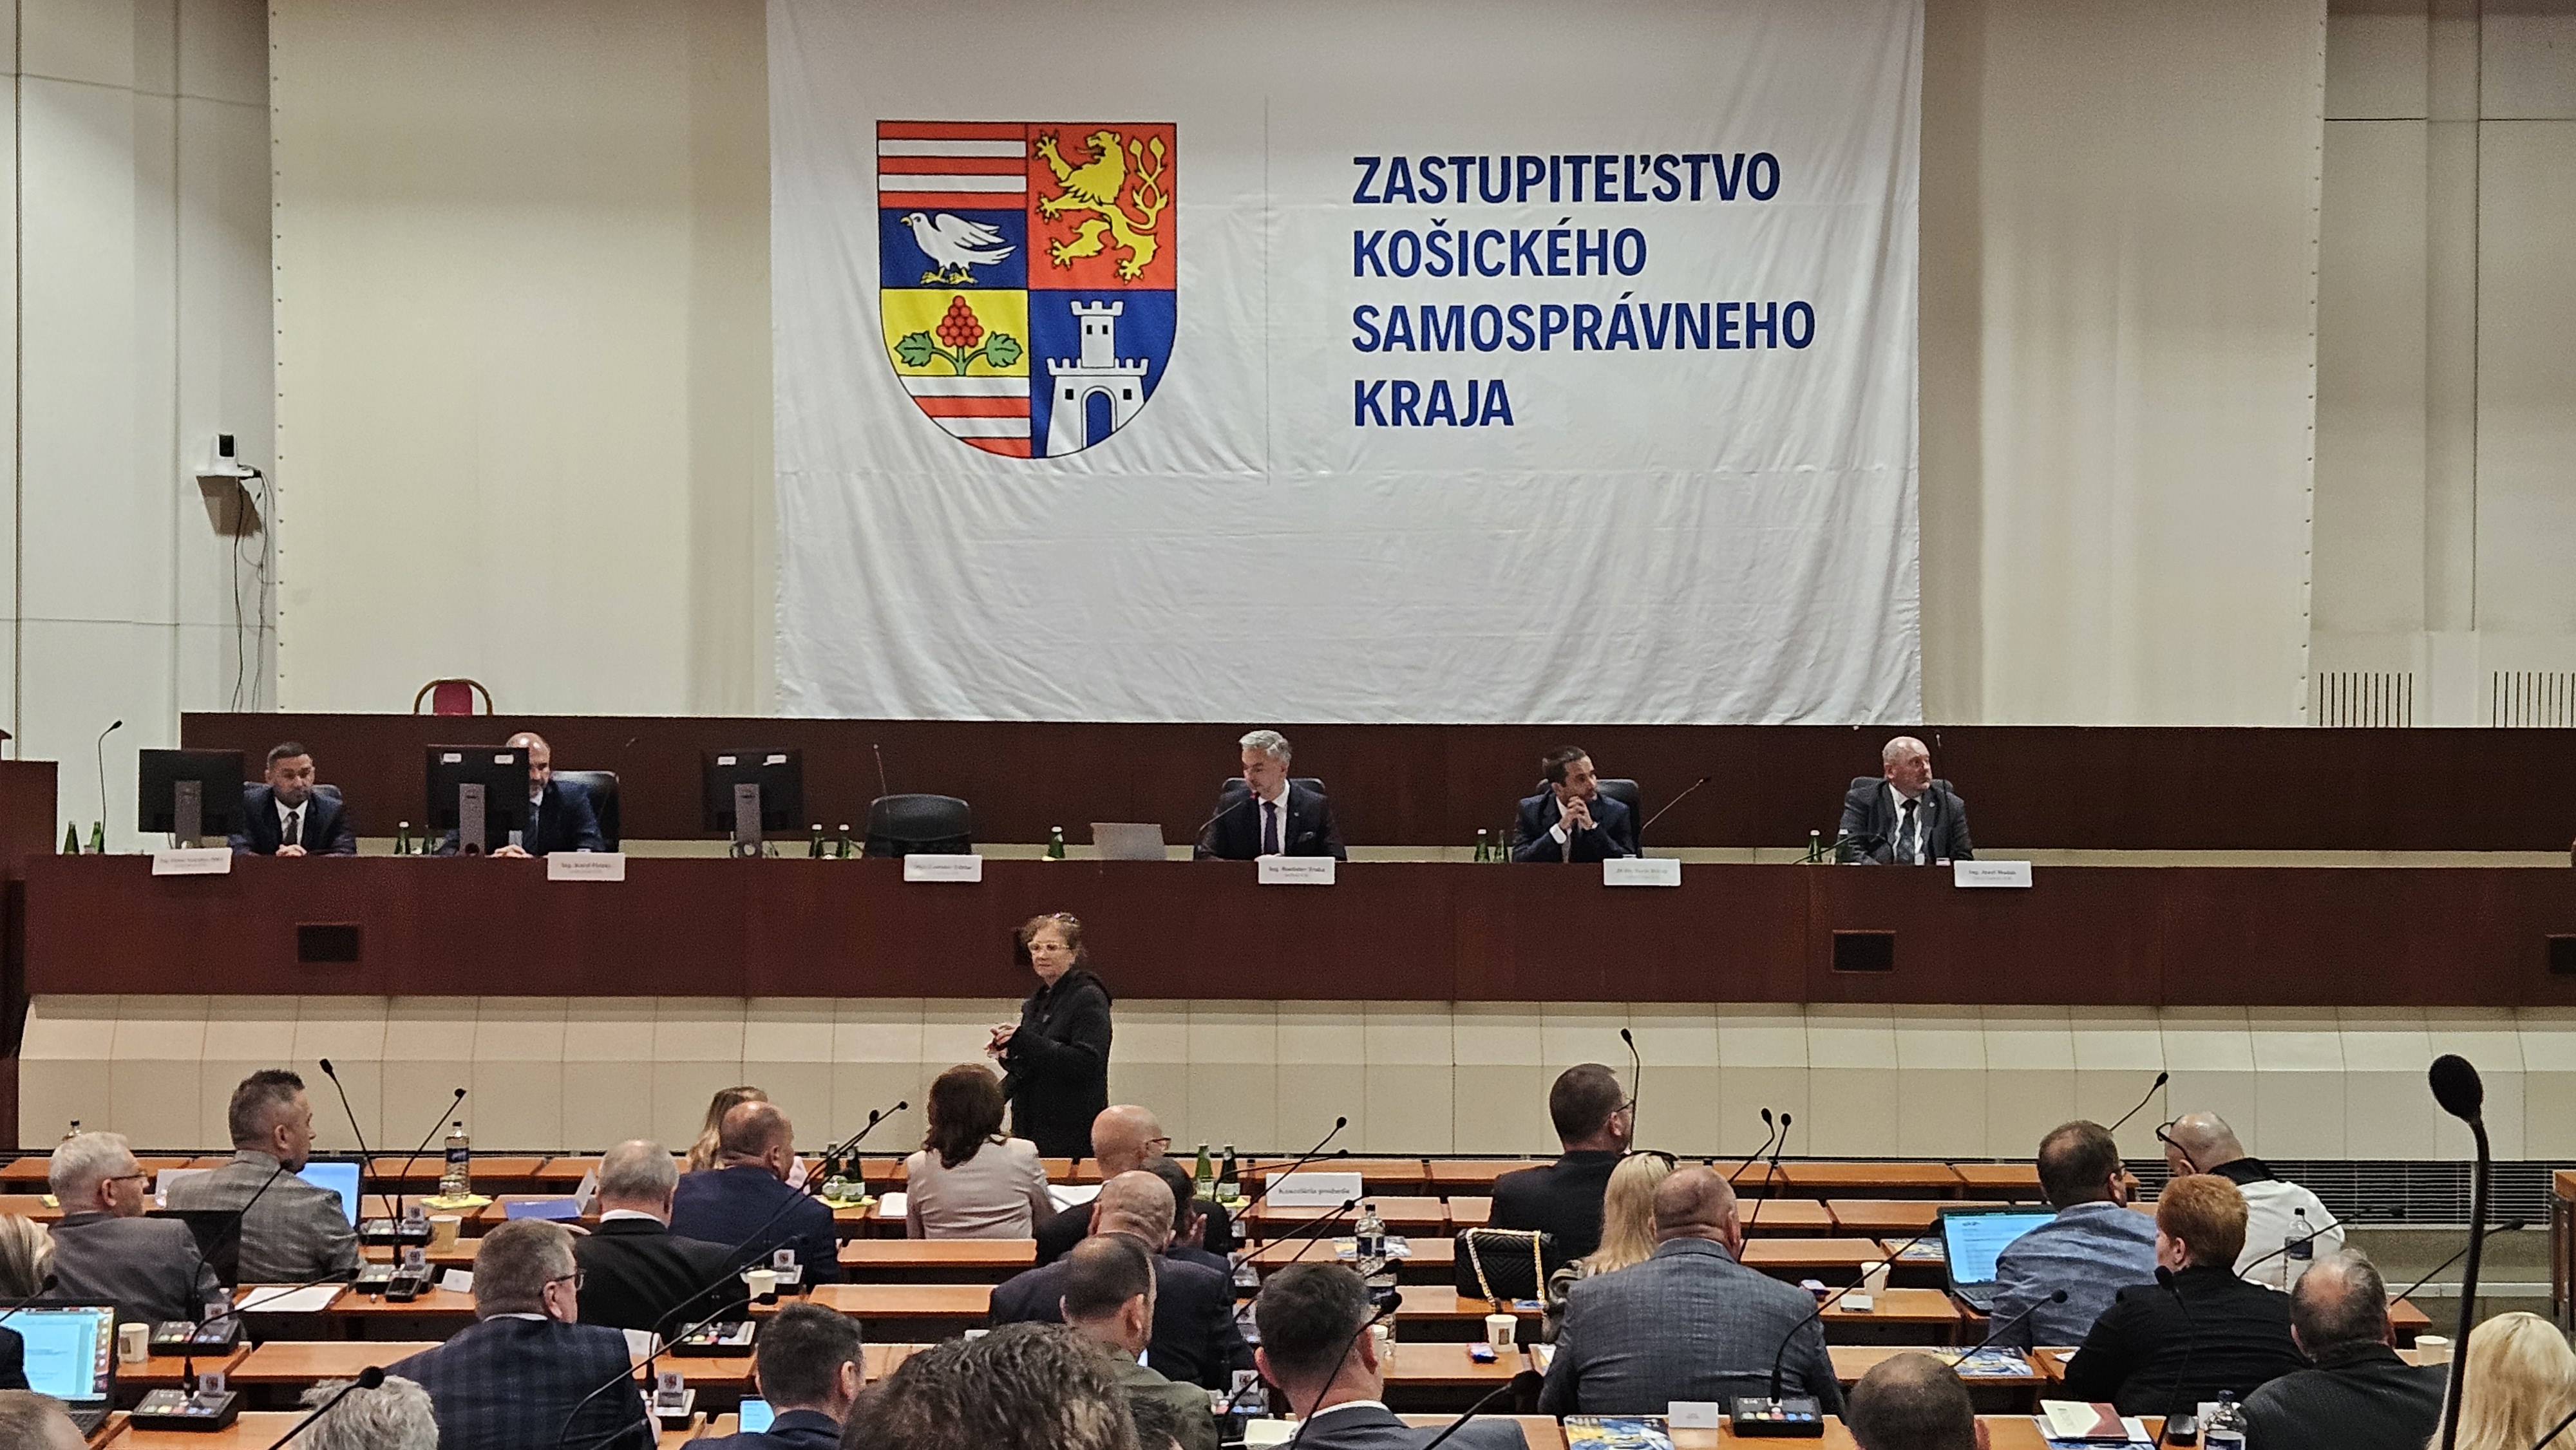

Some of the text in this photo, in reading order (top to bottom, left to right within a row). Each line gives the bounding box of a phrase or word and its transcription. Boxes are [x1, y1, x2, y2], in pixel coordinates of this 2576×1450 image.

[1353, 153, 1781, 204] ZASTUPITEĽSTVO
[1353, 217, 1647, 278] KOŠICKÉHO
[1352, 291, 1815, 352] SAMOSPRÁVNEHO
[1354, 379, 1514, 428] KRAJA
